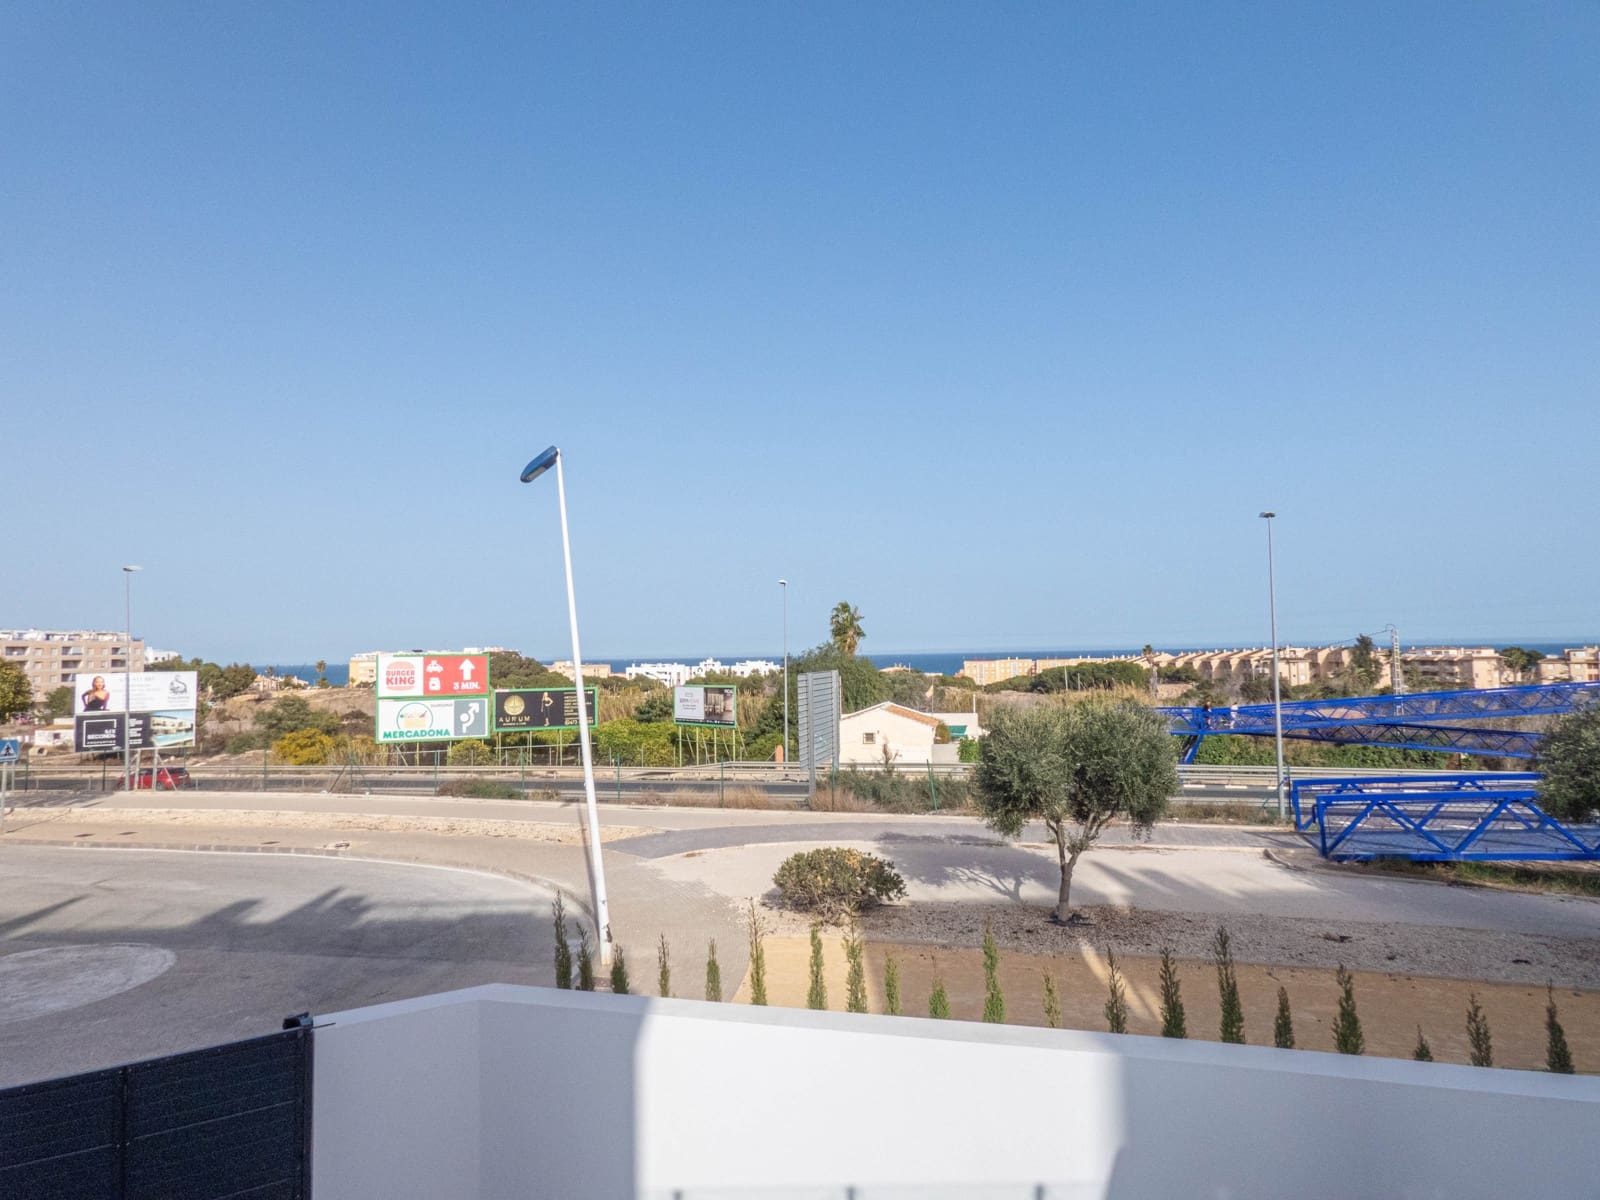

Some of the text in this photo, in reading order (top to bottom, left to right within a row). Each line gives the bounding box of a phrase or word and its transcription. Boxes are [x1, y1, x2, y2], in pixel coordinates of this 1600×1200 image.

[386, 677, 415, 685] KING
[453, 681, 481, 690] 3 MIN.
[383, 729, 451, 739] MERCADONA
